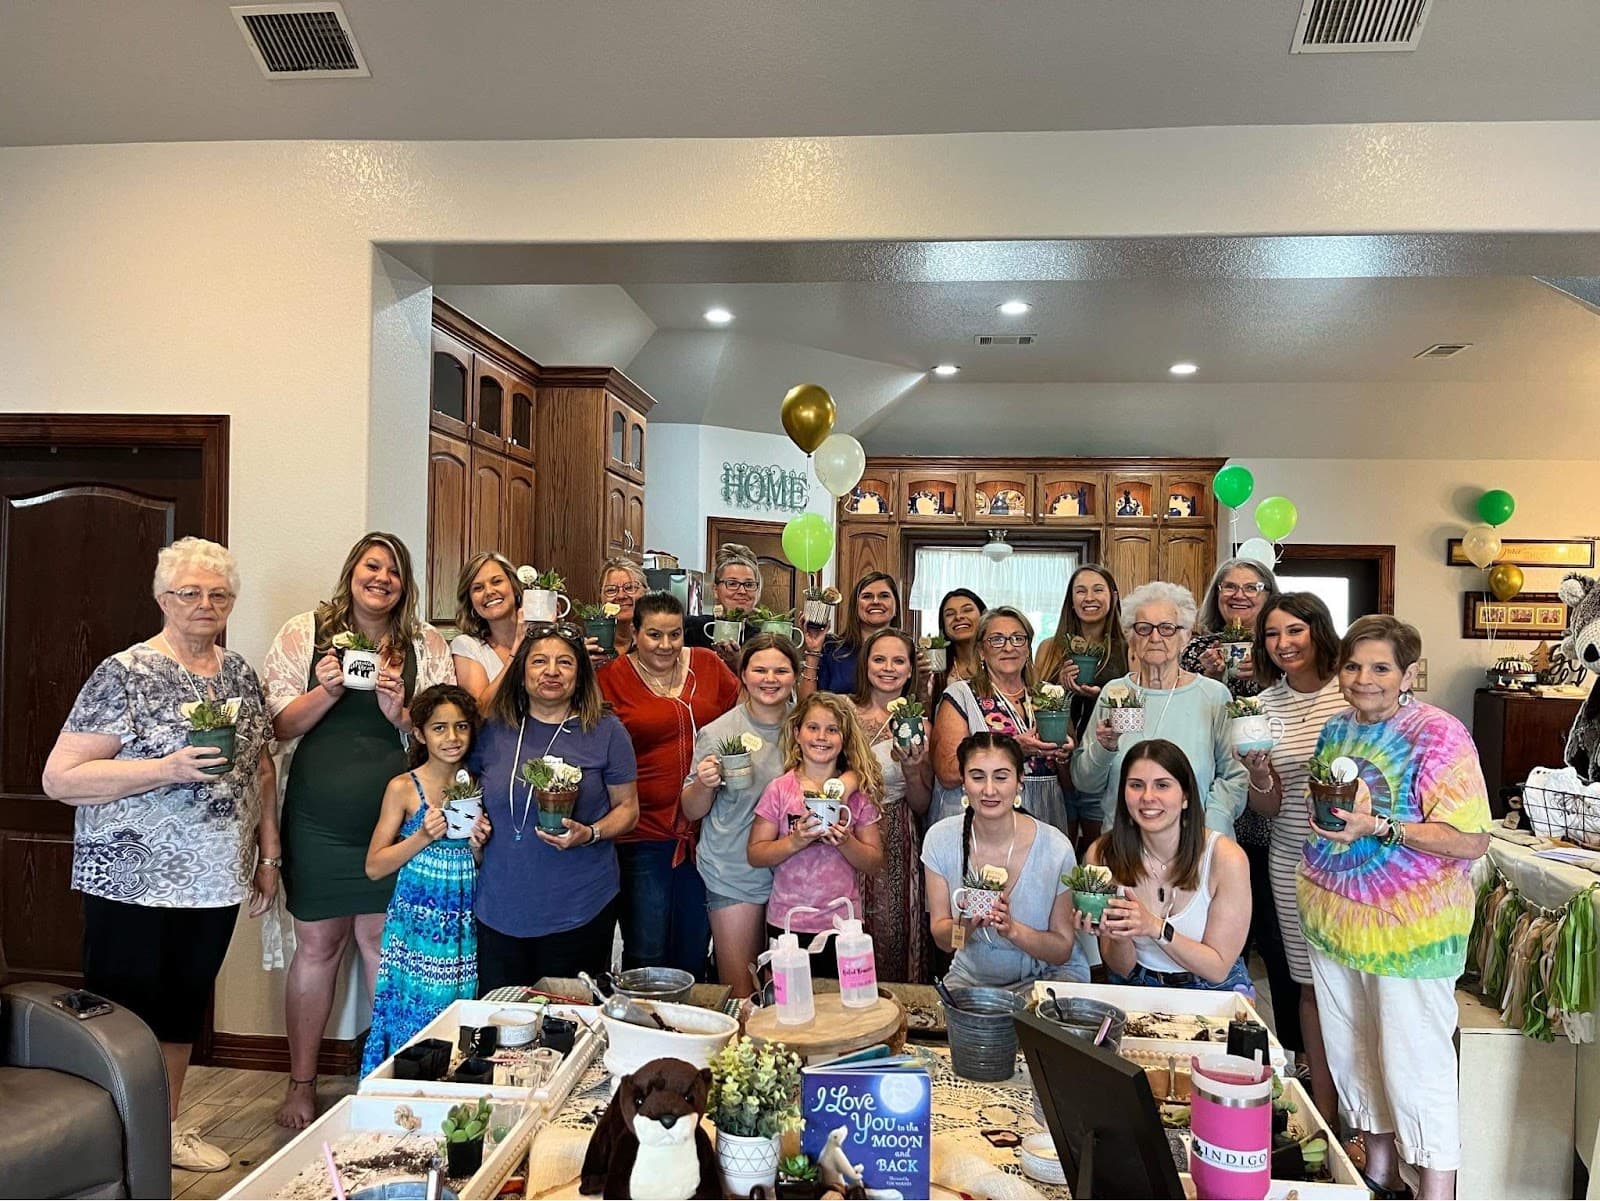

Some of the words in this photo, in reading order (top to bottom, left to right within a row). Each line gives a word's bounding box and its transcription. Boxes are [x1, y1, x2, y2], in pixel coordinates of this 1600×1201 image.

[721, 462, 810, 513] HOME
[811, 1086, 826, 1112] I
[825, 1085, 877, 1115] Love
[897, 1123, 905, 1132] to
[906, 1121, 919, 1132] the
[871, 1135, 923, 1148] MOON
[894, 1147, 911, 1158] and
[1205, 1146, 1267, 1166] INDIGO
[876, 1158, 918, 1172] BACK
